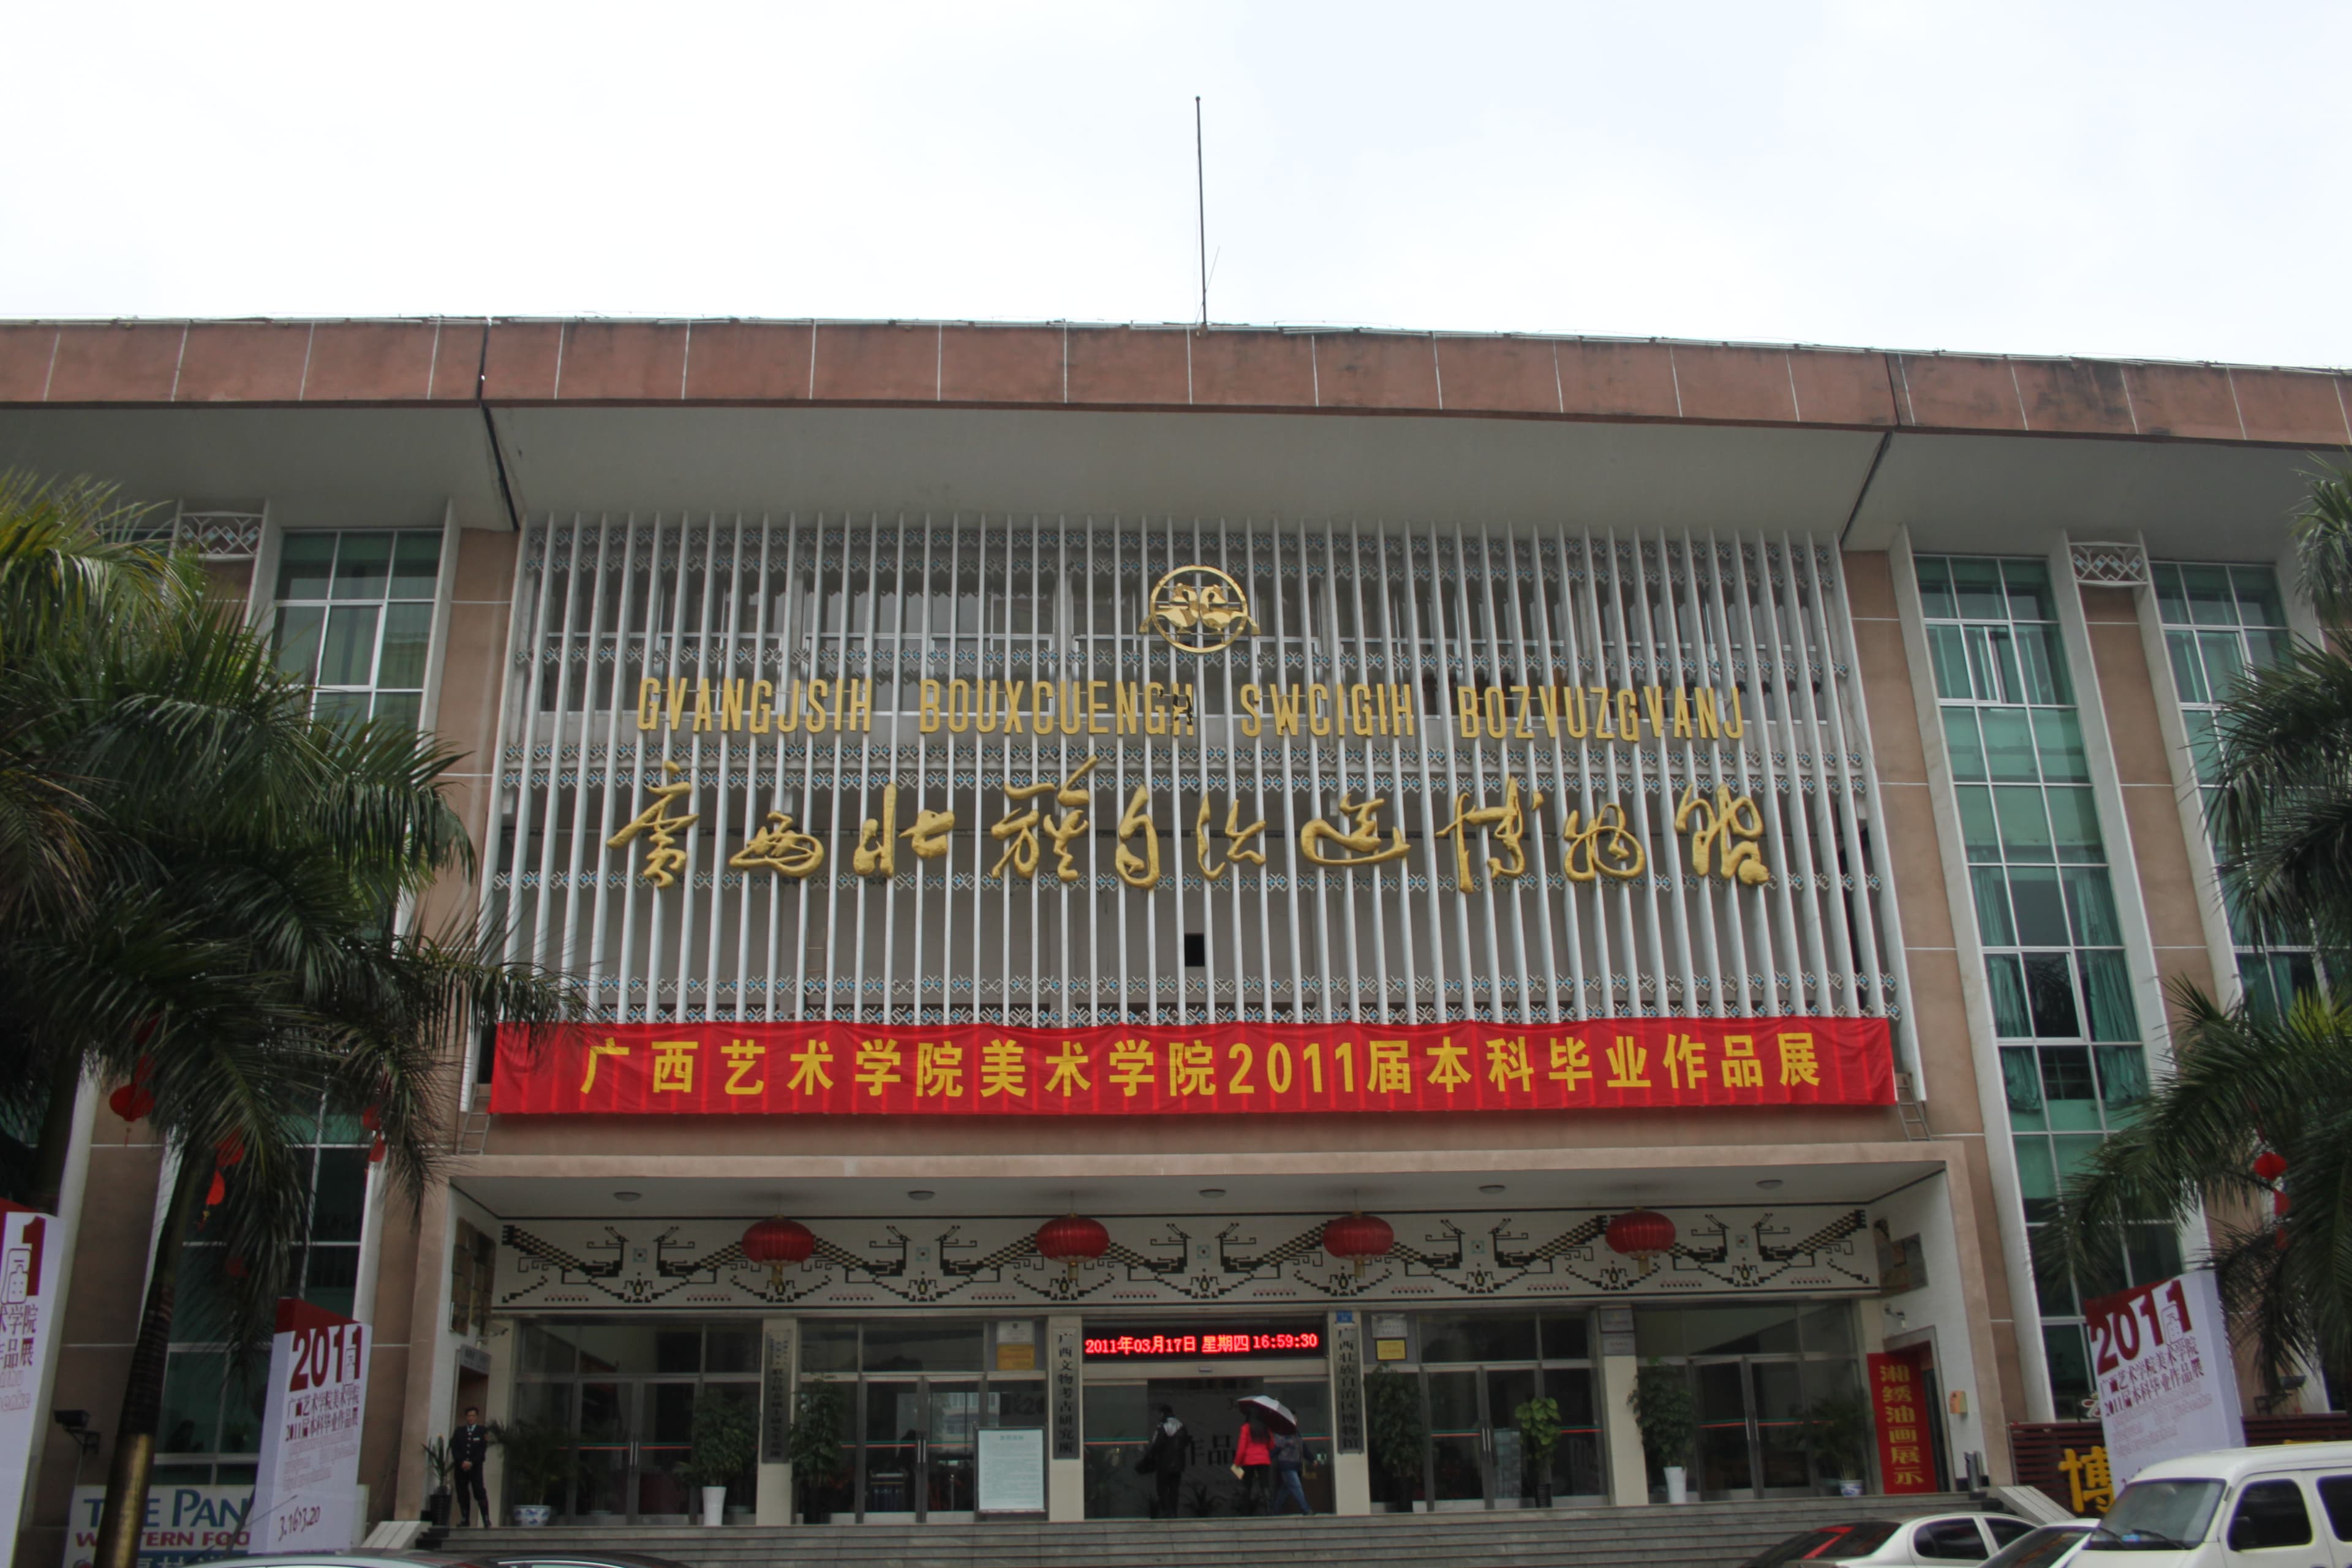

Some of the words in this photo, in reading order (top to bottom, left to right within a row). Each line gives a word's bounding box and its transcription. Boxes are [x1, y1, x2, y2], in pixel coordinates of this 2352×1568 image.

[637, 677, 872, 733] GVANGJSIH
[920, 679, 1193, 736] BOUXCUENGH
[1240, 683, 1415, 738] SWCIGIH
[1457, 685, 1744, 742] BOZVUZGVANJ
[579, 1031, 1821, 1098] 广西艺术学院美术学院2011届本科毕业作品展
[289, 1325, 363, 1392] 2011
[1085, 1335, 1196, 1355] 2011年03月17日
[1202, 1335, 1250, 1354] 星期四
[1253, 1333, 1318, 1349] 16:59:30
[2089, 1278, 2193, 1377] 2011
[1879, 1364, 1924, 1485] 湘绣油画展示
[83, 1498, 160, 1528] TE
